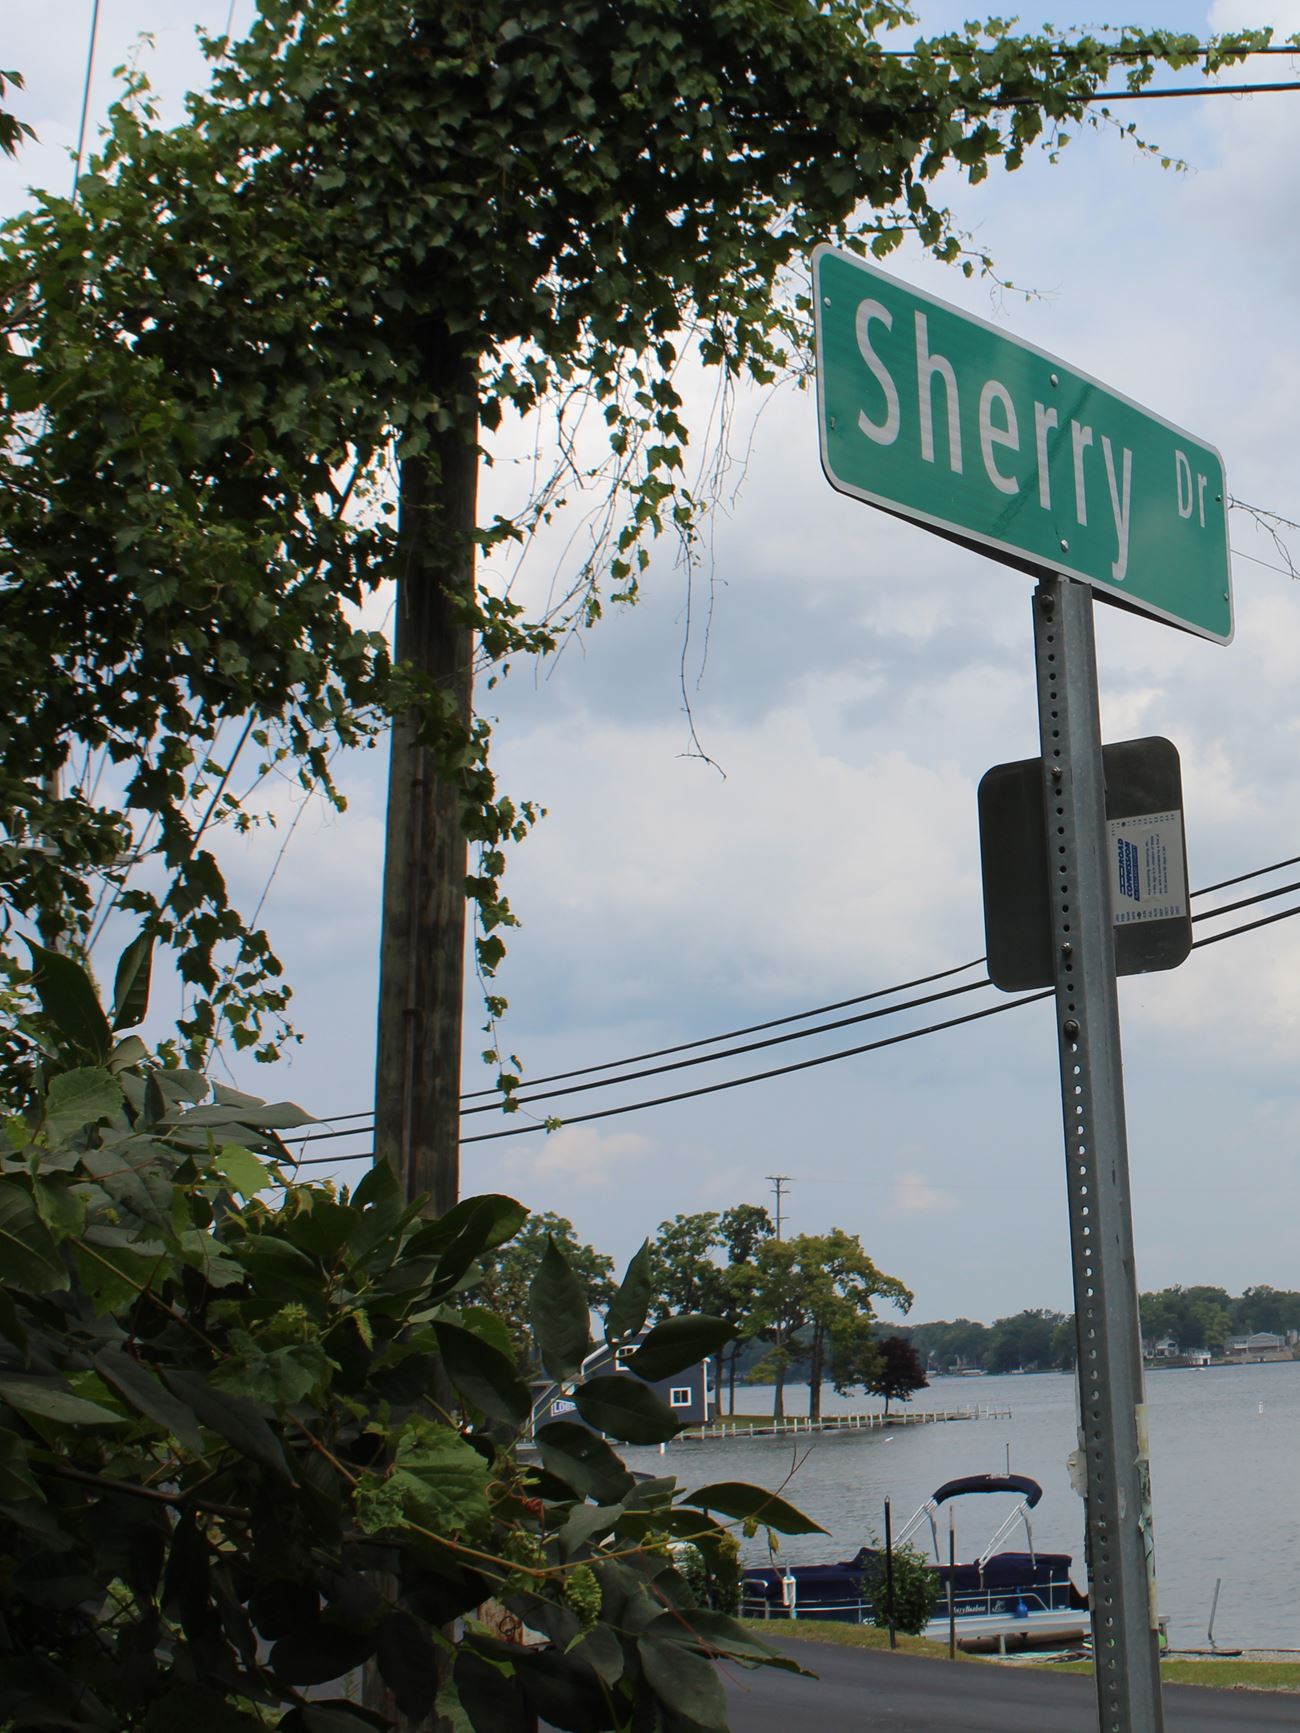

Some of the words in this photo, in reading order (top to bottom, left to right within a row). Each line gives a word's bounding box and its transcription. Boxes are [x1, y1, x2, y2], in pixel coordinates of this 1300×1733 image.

[855, 298, 1132, 581] Sherry
[1175, 449, 1208, 528] Dr
[1117, 838, 1125, 865] ROAD
[1124, 840, 1133, 897] COMMISSION
